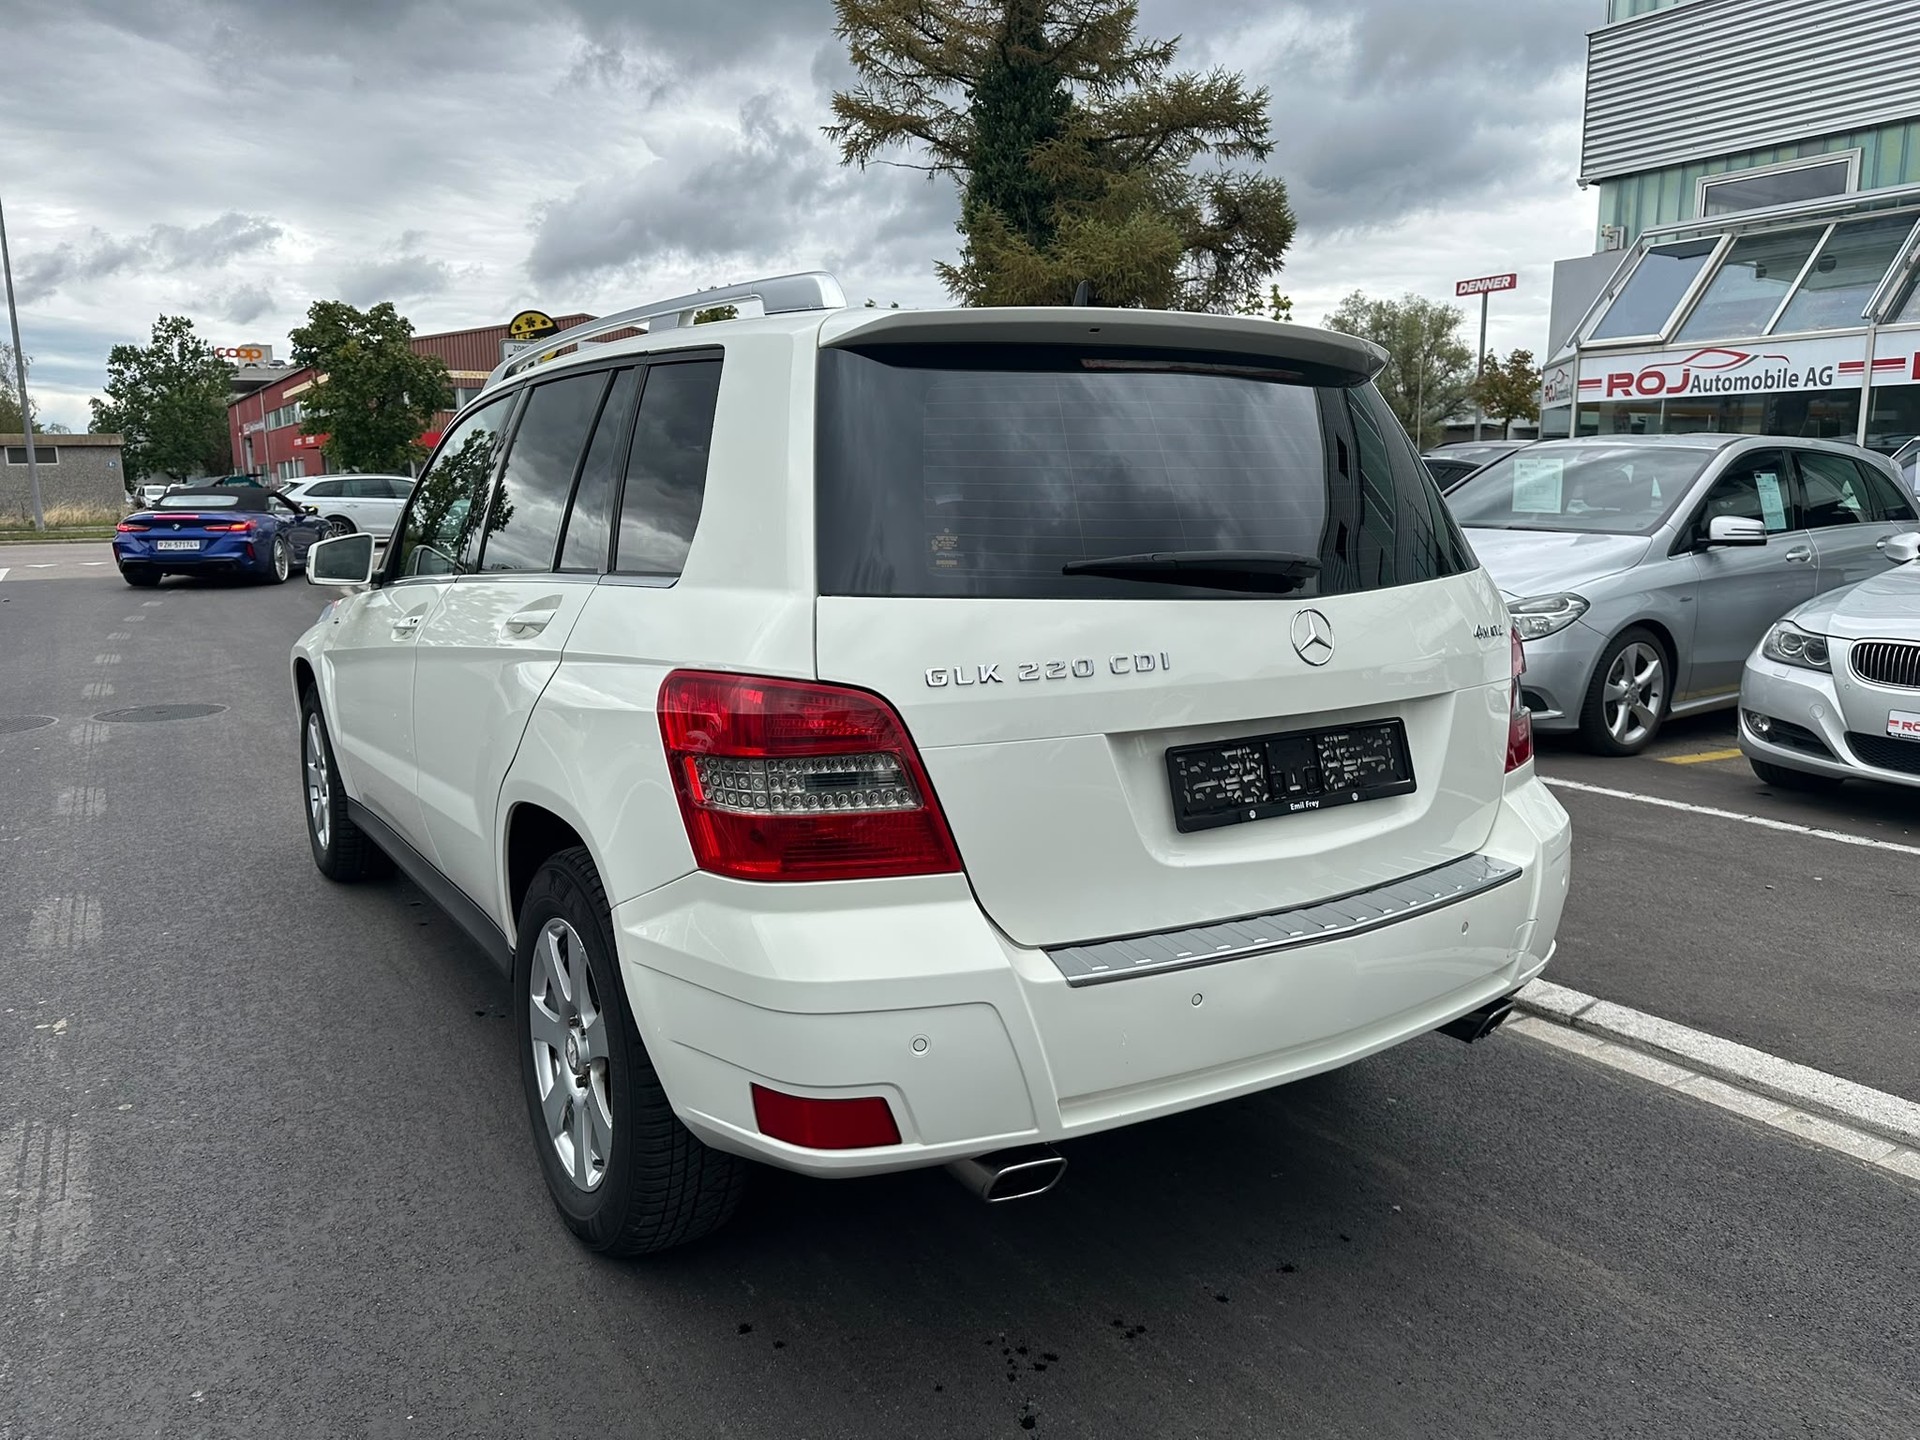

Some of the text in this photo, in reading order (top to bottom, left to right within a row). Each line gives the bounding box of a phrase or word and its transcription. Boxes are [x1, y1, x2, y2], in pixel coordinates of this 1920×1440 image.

[1458, 276, 1511, 294] DENNER
[214, 347, 262, 362] coop
[1606, 365, 1834, 398] ROJ Automobile AG
[925, 651, 1171, 688] GLK 220 CDI
[1290, 800, 1319, 810] Emil Frey
